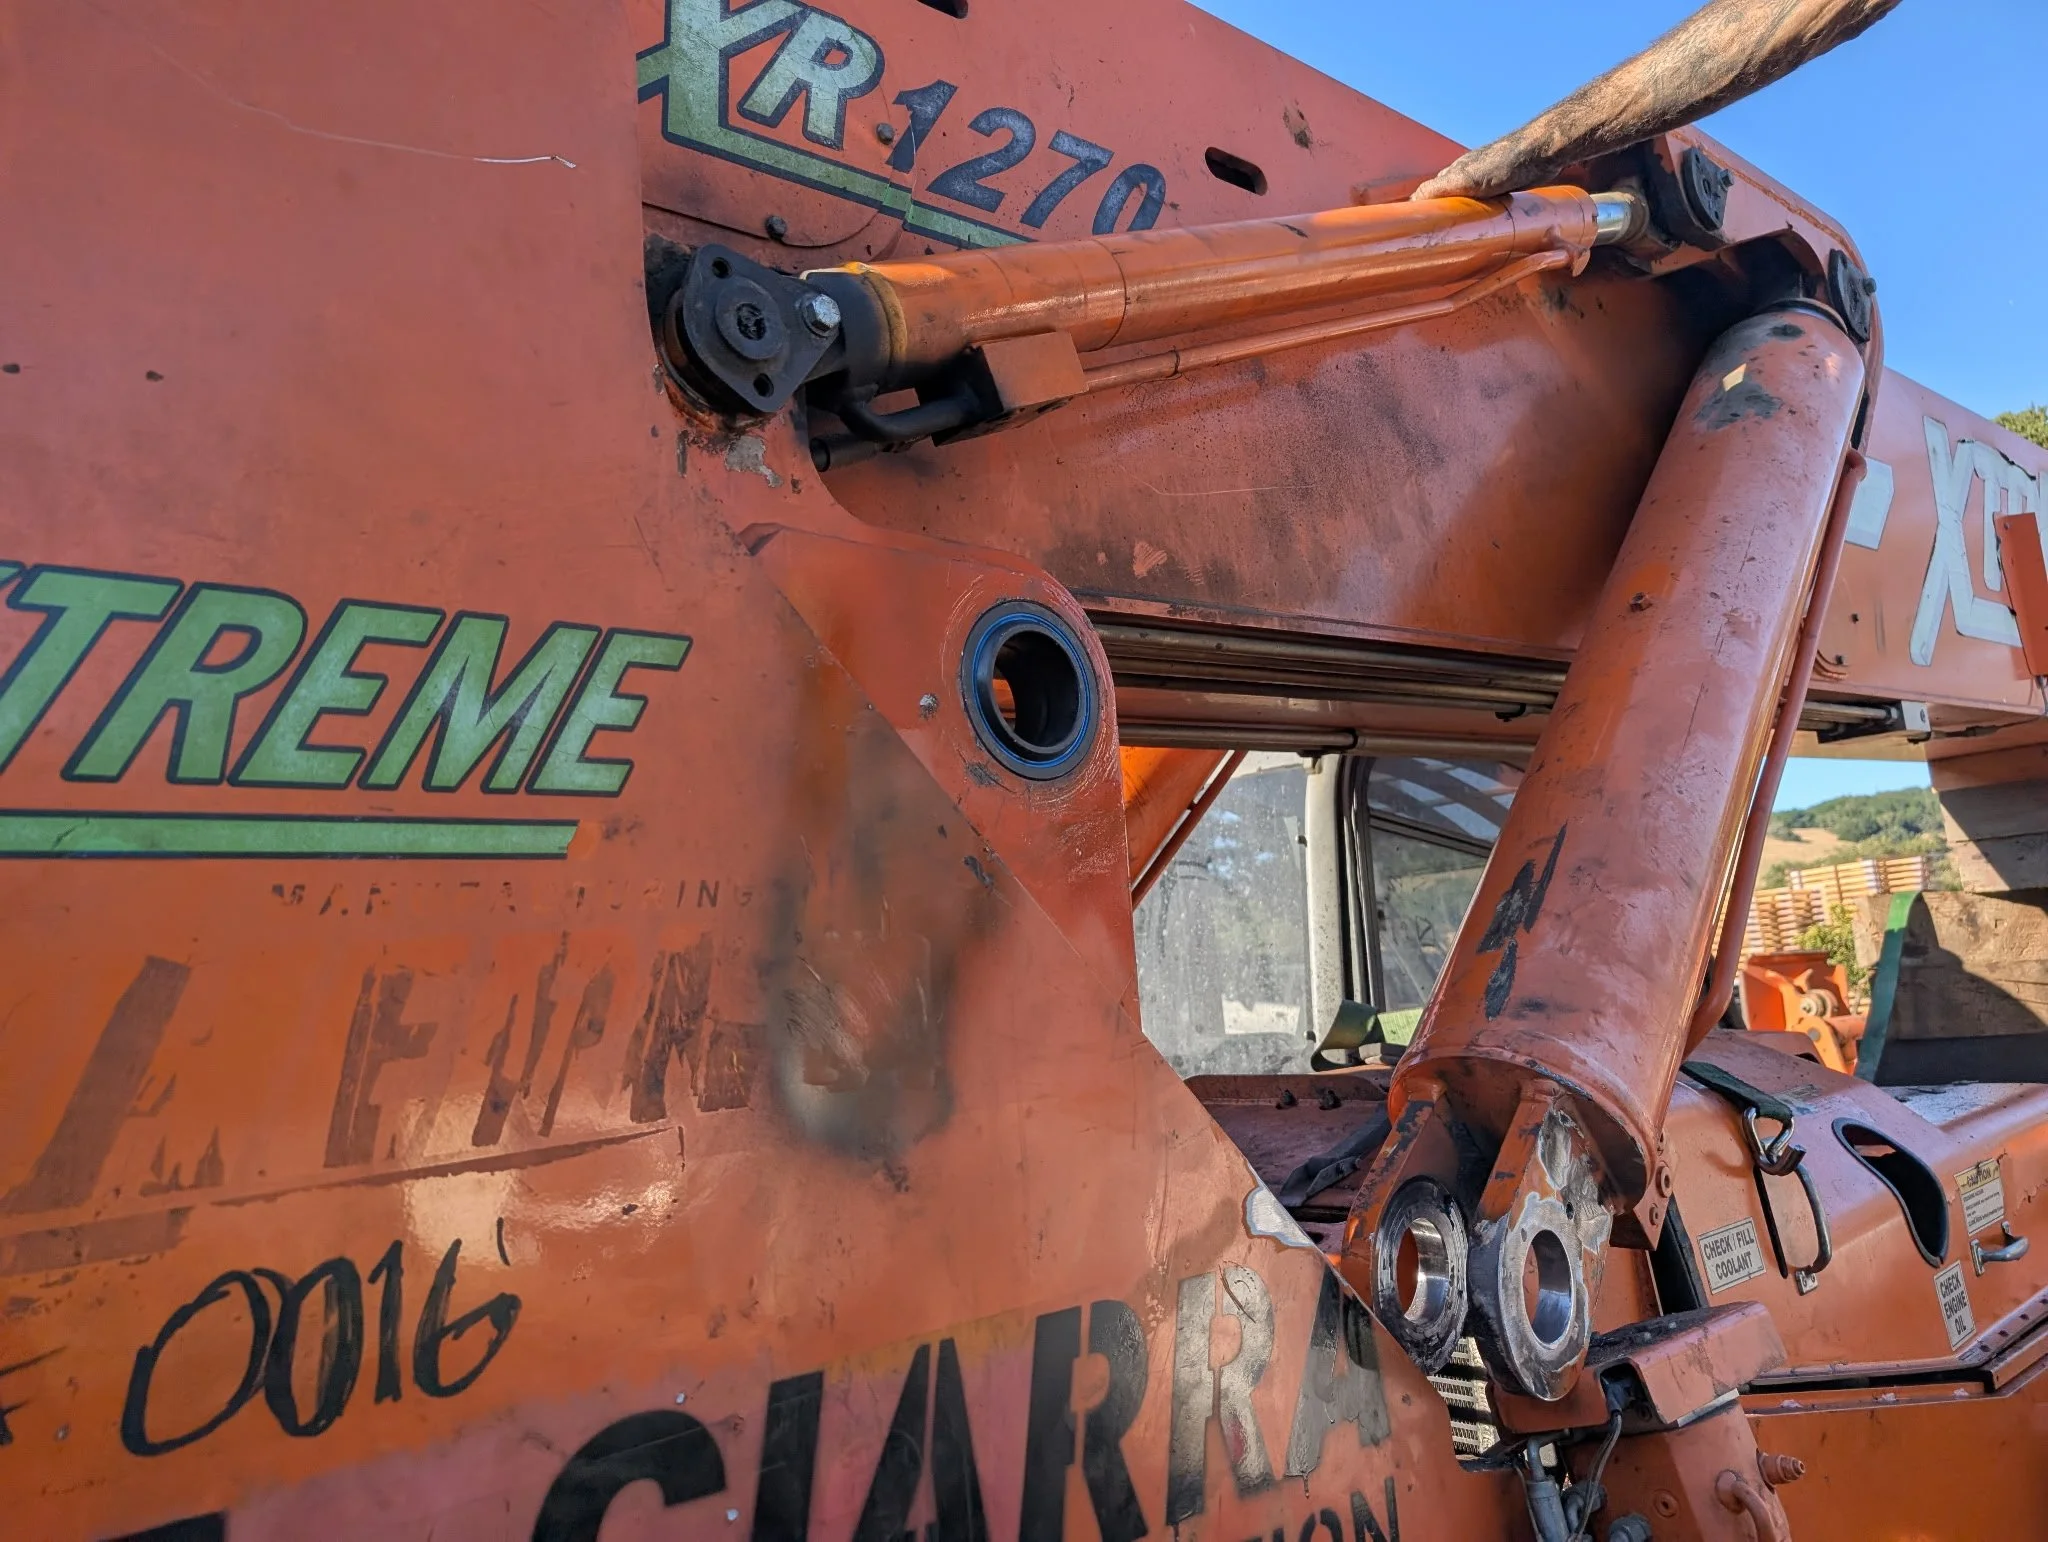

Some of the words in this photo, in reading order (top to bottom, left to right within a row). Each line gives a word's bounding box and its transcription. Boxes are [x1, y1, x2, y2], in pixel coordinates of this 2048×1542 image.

[0, 560, 692, 797] TREME
[1966, 1167, 1992, 1188] CAUTION
[1704, 1235, 1733, 1260] CHECK
[1736, 1228, 1754, 1248] FILL
[1715, 1251, 1753, 1280] COOLANT
[1940, 1271, 1961, 1298] CHECK
[1944, 1290, 1967, 1319] ENGINE
[1955, 1315, 1967, 1335] OIL
[120, 1239, 521, 1456] 0016
